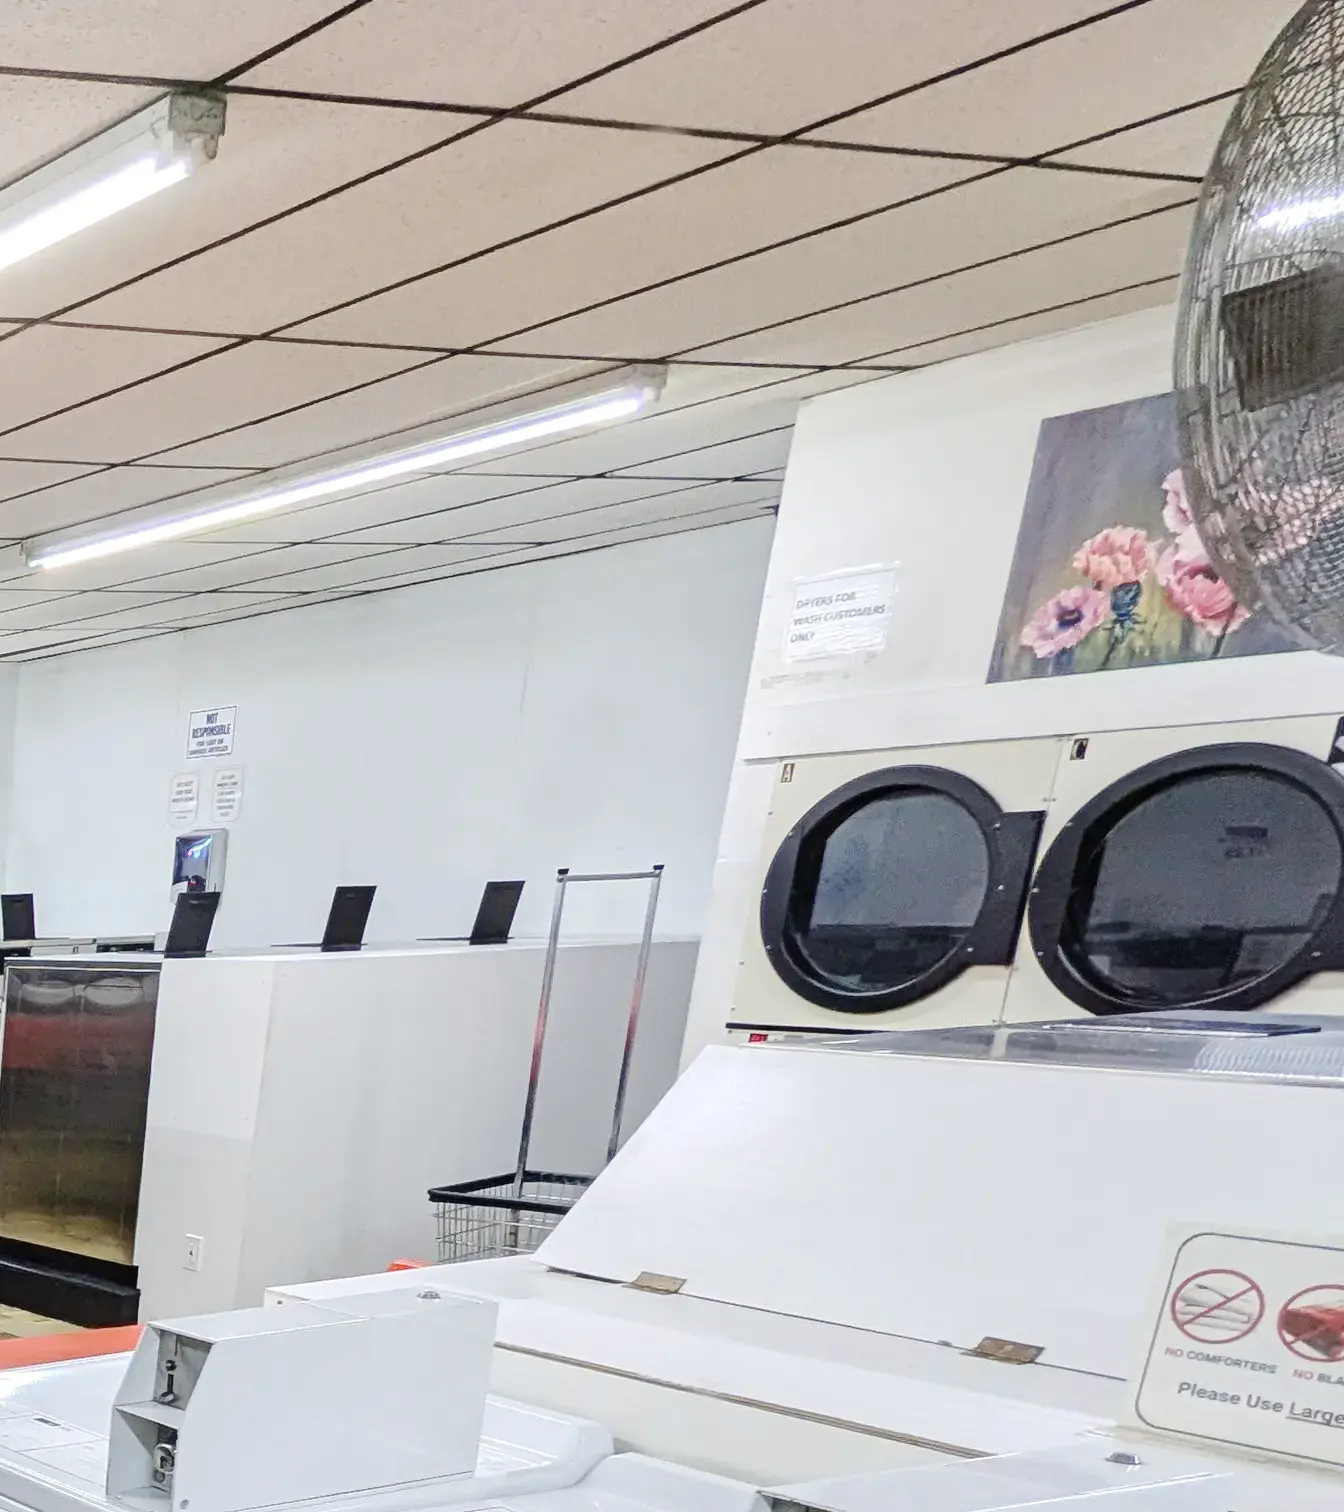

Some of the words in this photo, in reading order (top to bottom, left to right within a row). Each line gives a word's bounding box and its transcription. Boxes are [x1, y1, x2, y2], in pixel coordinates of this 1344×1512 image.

[796, 595, 833, 609] DRYERS
[835, 592, 857, 603] FOR
[824, 604, 886, 621] CUSTOMERS
[790, 632, 815, 643] ONLY
[1164, 1347, 1184, 1358] NO
[1186, 1350, 1278, 1374] COMFORTERS
[1292, 1369, 1314, 1380] NO
[1177, 1382, 1241, 1405] Please
[1246, 1394, 1284, 1412] Use
